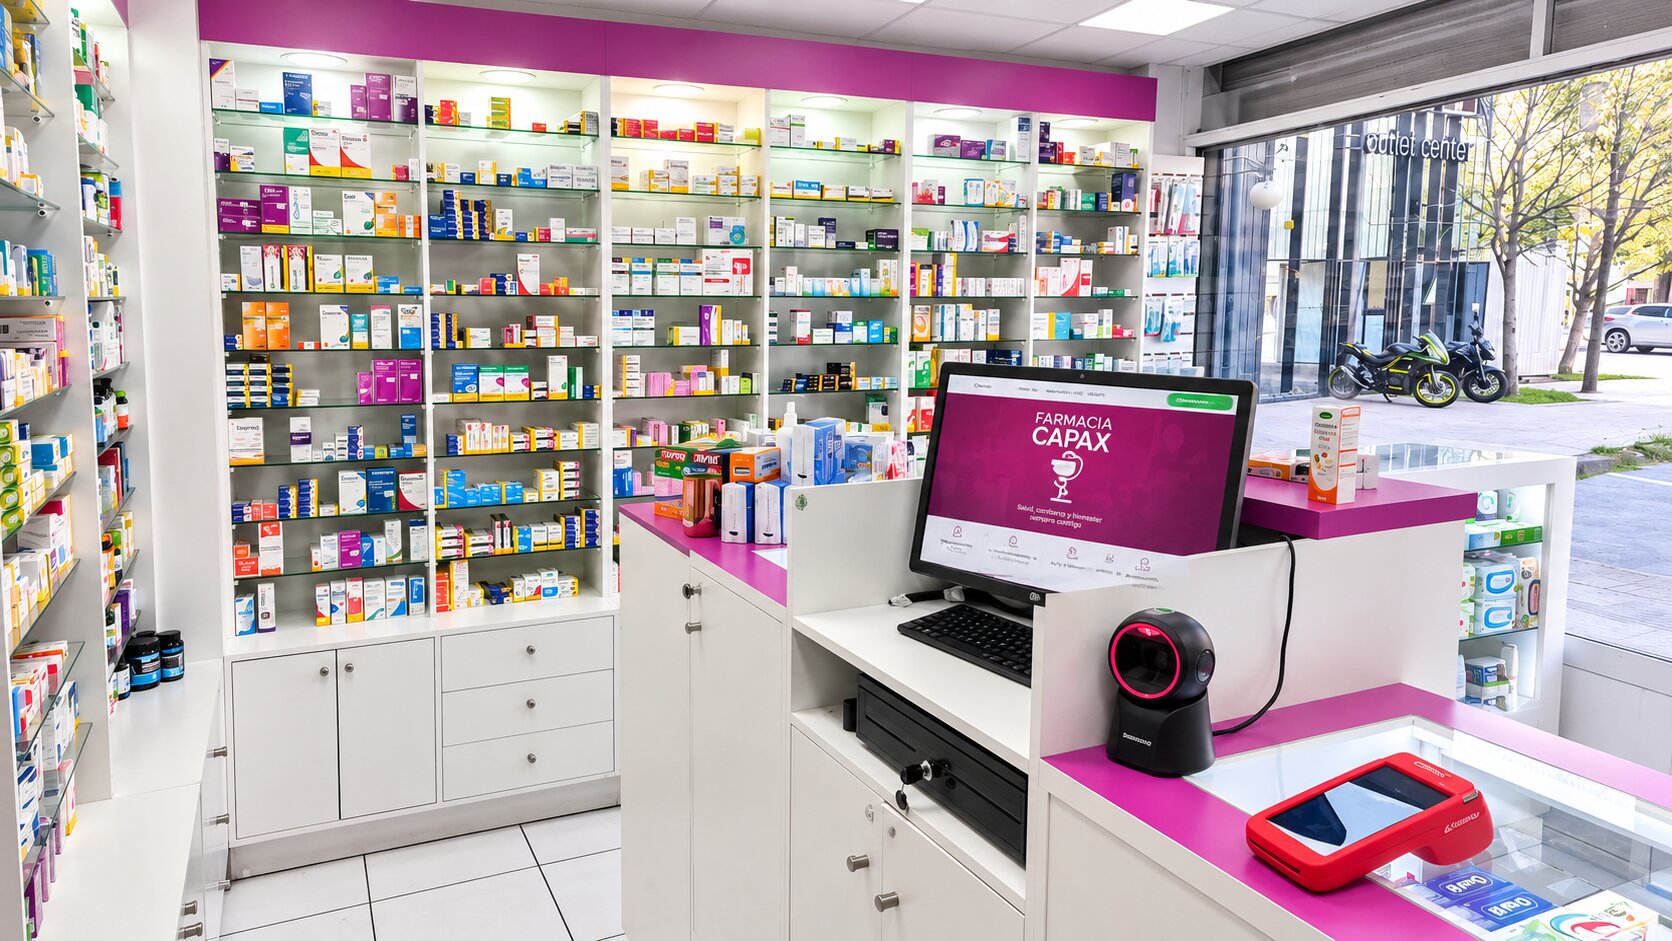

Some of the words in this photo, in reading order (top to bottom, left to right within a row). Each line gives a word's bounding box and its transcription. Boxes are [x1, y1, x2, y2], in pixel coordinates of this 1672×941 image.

[1366, 131, 1415, 157] outlet
[1035, 411, 1112, 431] FARMACIA
[1032, 426, 1112, 453] CAPAX
